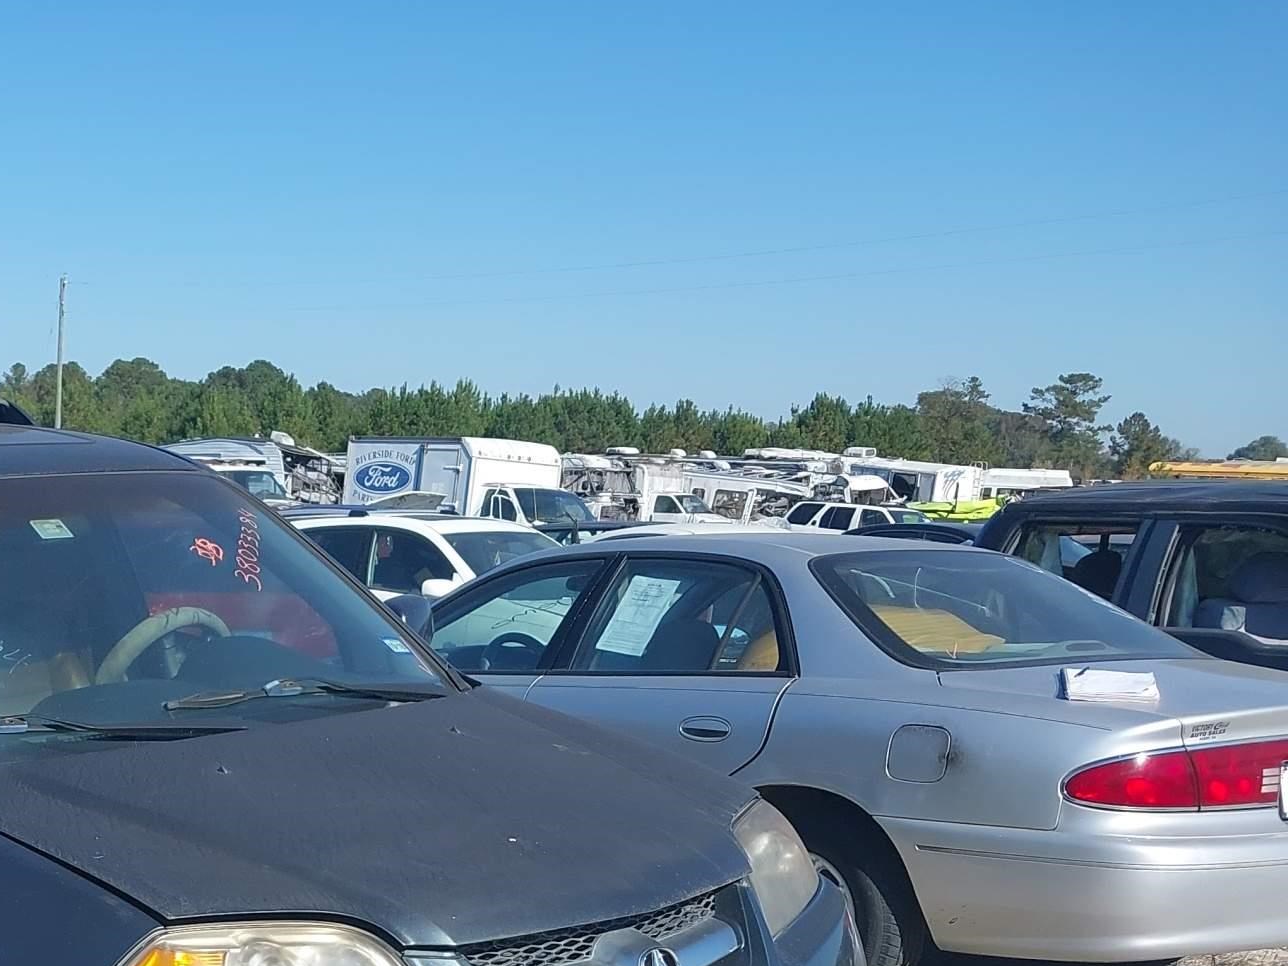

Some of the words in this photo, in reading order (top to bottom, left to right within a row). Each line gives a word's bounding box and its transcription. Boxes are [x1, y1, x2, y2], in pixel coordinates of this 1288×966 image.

[355, 450, 394, 466] RIVERSIDE
[364, 465, 401, 488] Ford
[234, 507, 262, 592] 38033384
[1208, 728, 1226, 736] SALES
